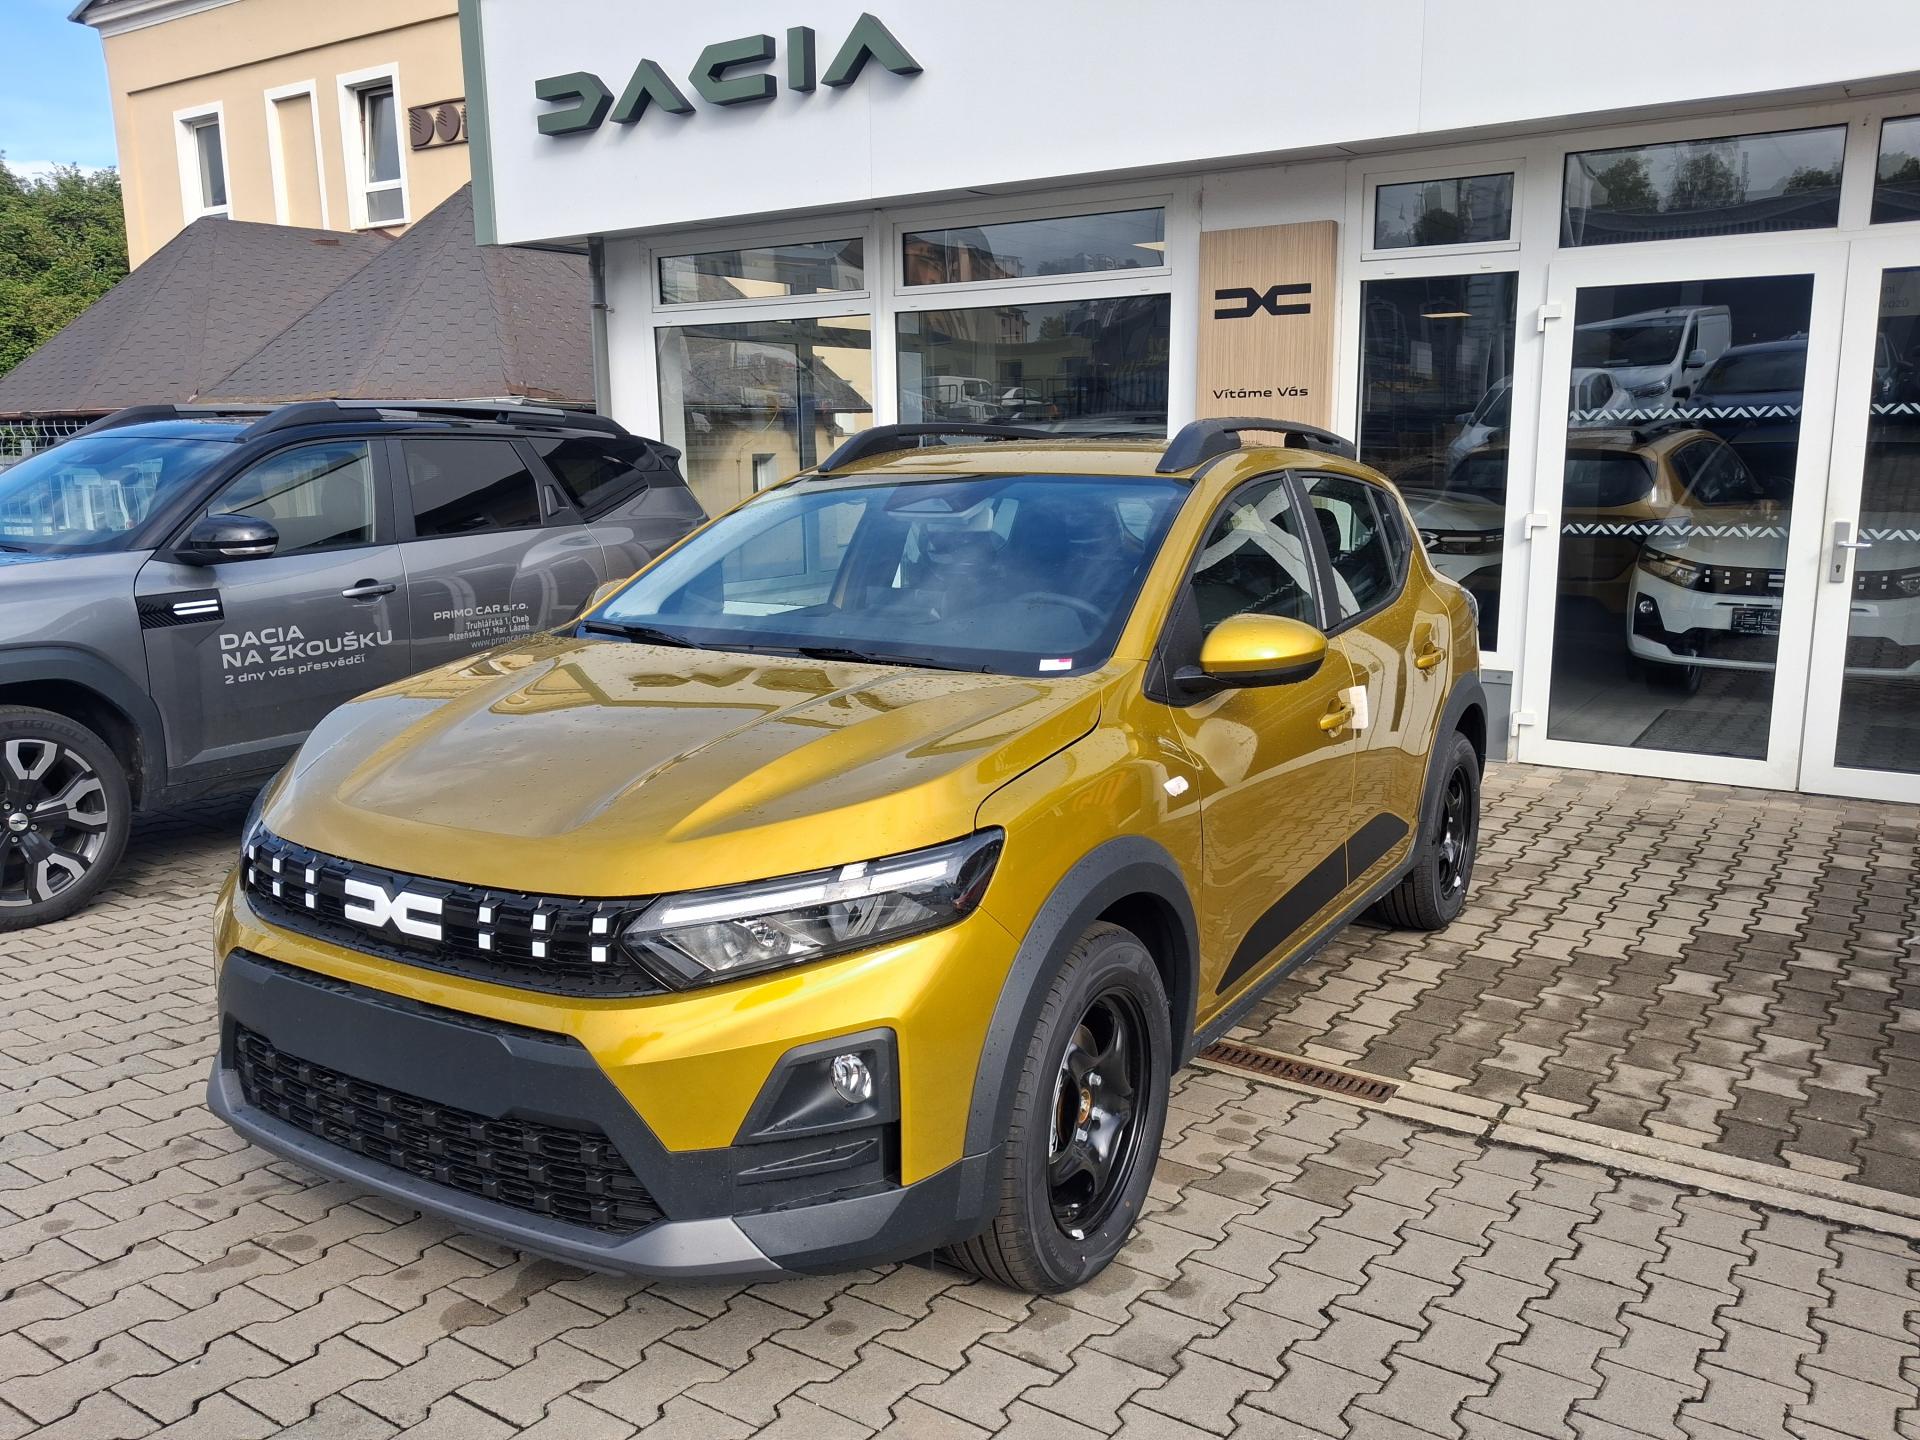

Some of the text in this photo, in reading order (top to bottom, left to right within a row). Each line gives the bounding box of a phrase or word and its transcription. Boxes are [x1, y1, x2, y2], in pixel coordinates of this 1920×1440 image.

[535, 12, 924, 136] DACIA
[1213, 386, 1309, 399] Vítáme Vás
[433, 603, 529, 621] PRIMO CAR s.r.o.
[466, 617, 503, 630] Truhlářská
[511, 614, 530, 624] Cheb
[219, 625, 305, 650] DACIA
[449, 623, 530, 641] Plzeňská 17, Mar. Lázně
[222, 630, 393, 669] NA ZKOUŠKU
[224, 653, 367, 684] 2 dny vás přesvědčí
